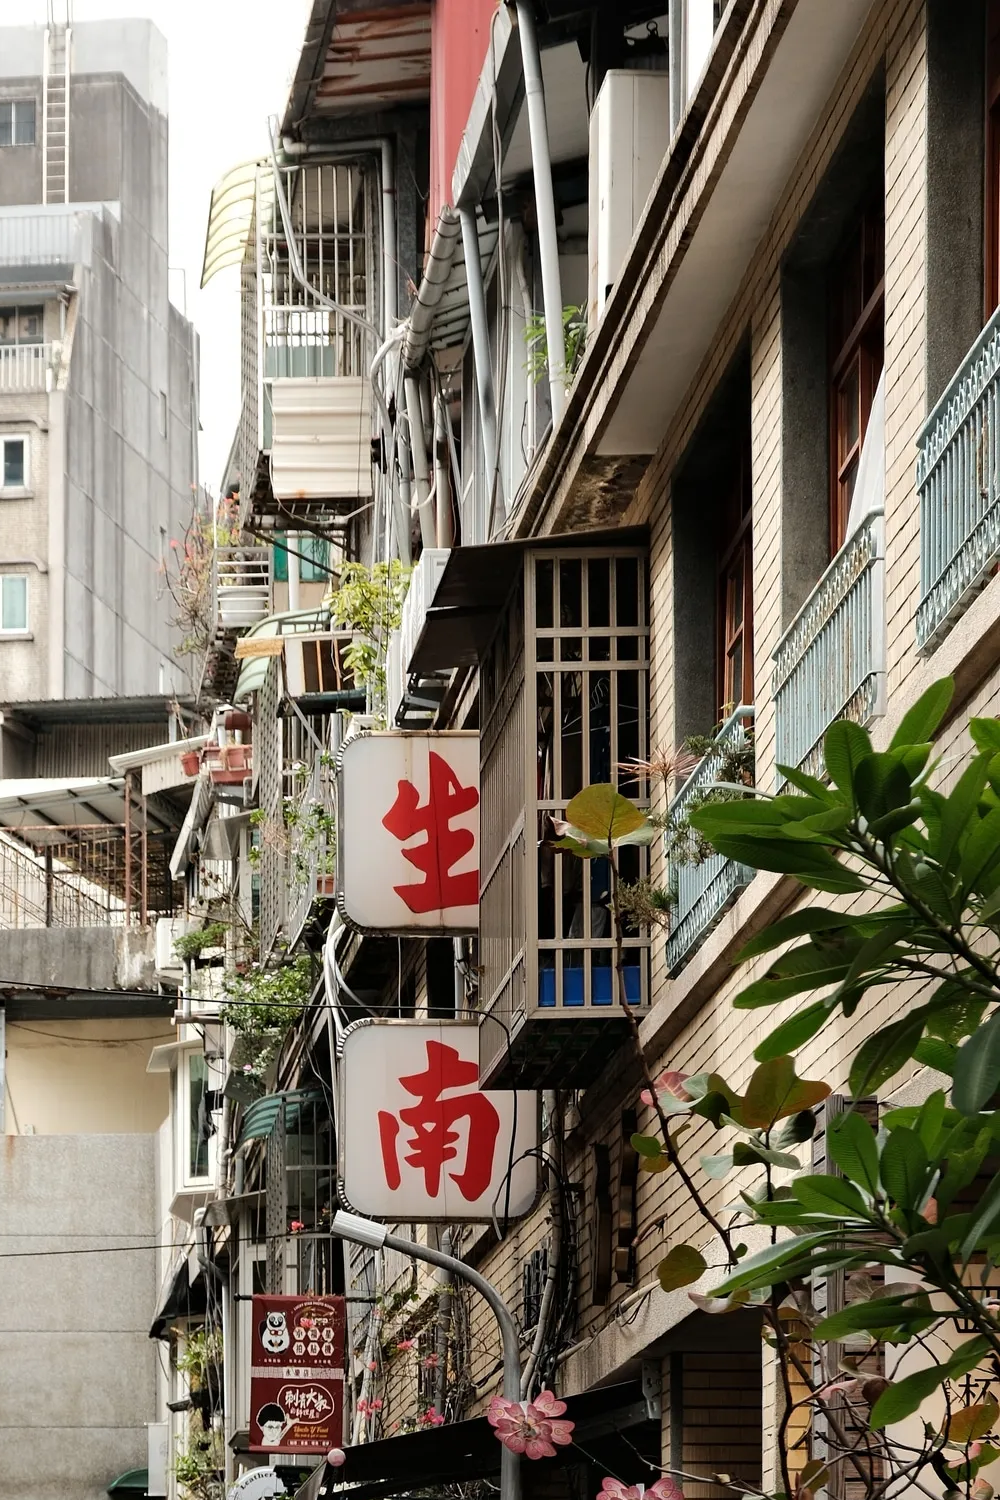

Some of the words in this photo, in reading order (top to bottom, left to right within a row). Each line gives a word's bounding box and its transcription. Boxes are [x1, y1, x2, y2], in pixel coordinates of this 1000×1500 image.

[382, 751, 480, 914] 生
[378, 1040, 501, 1202] 南
[240, 1471, 274, 1490] Leather
